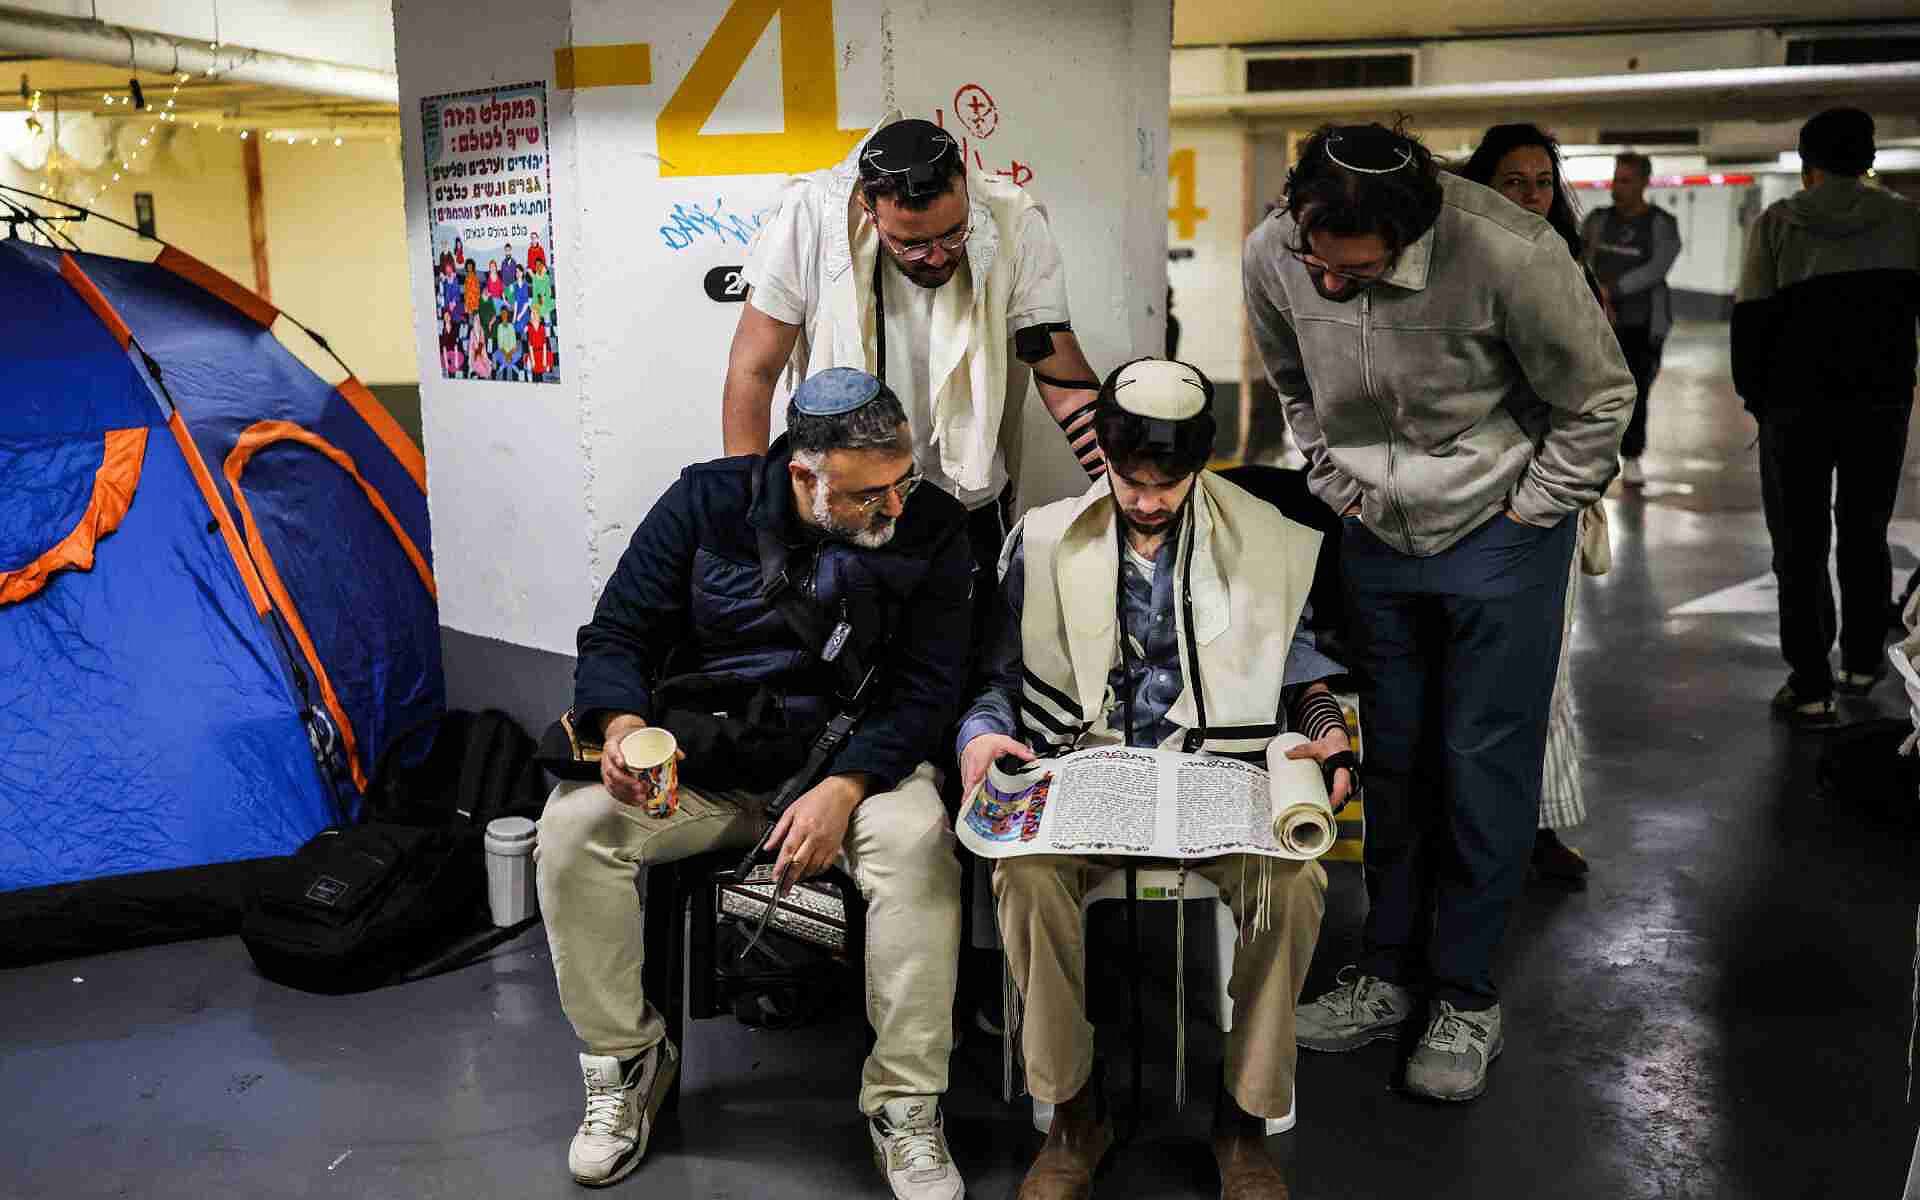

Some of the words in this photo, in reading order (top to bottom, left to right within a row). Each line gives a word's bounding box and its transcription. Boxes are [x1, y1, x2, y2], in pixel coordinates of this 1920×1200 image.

[480, 97, 536, 129] המקלט
[507, 154, 543, 172] יהודים
[472, 180, 506, 198] ונשים
